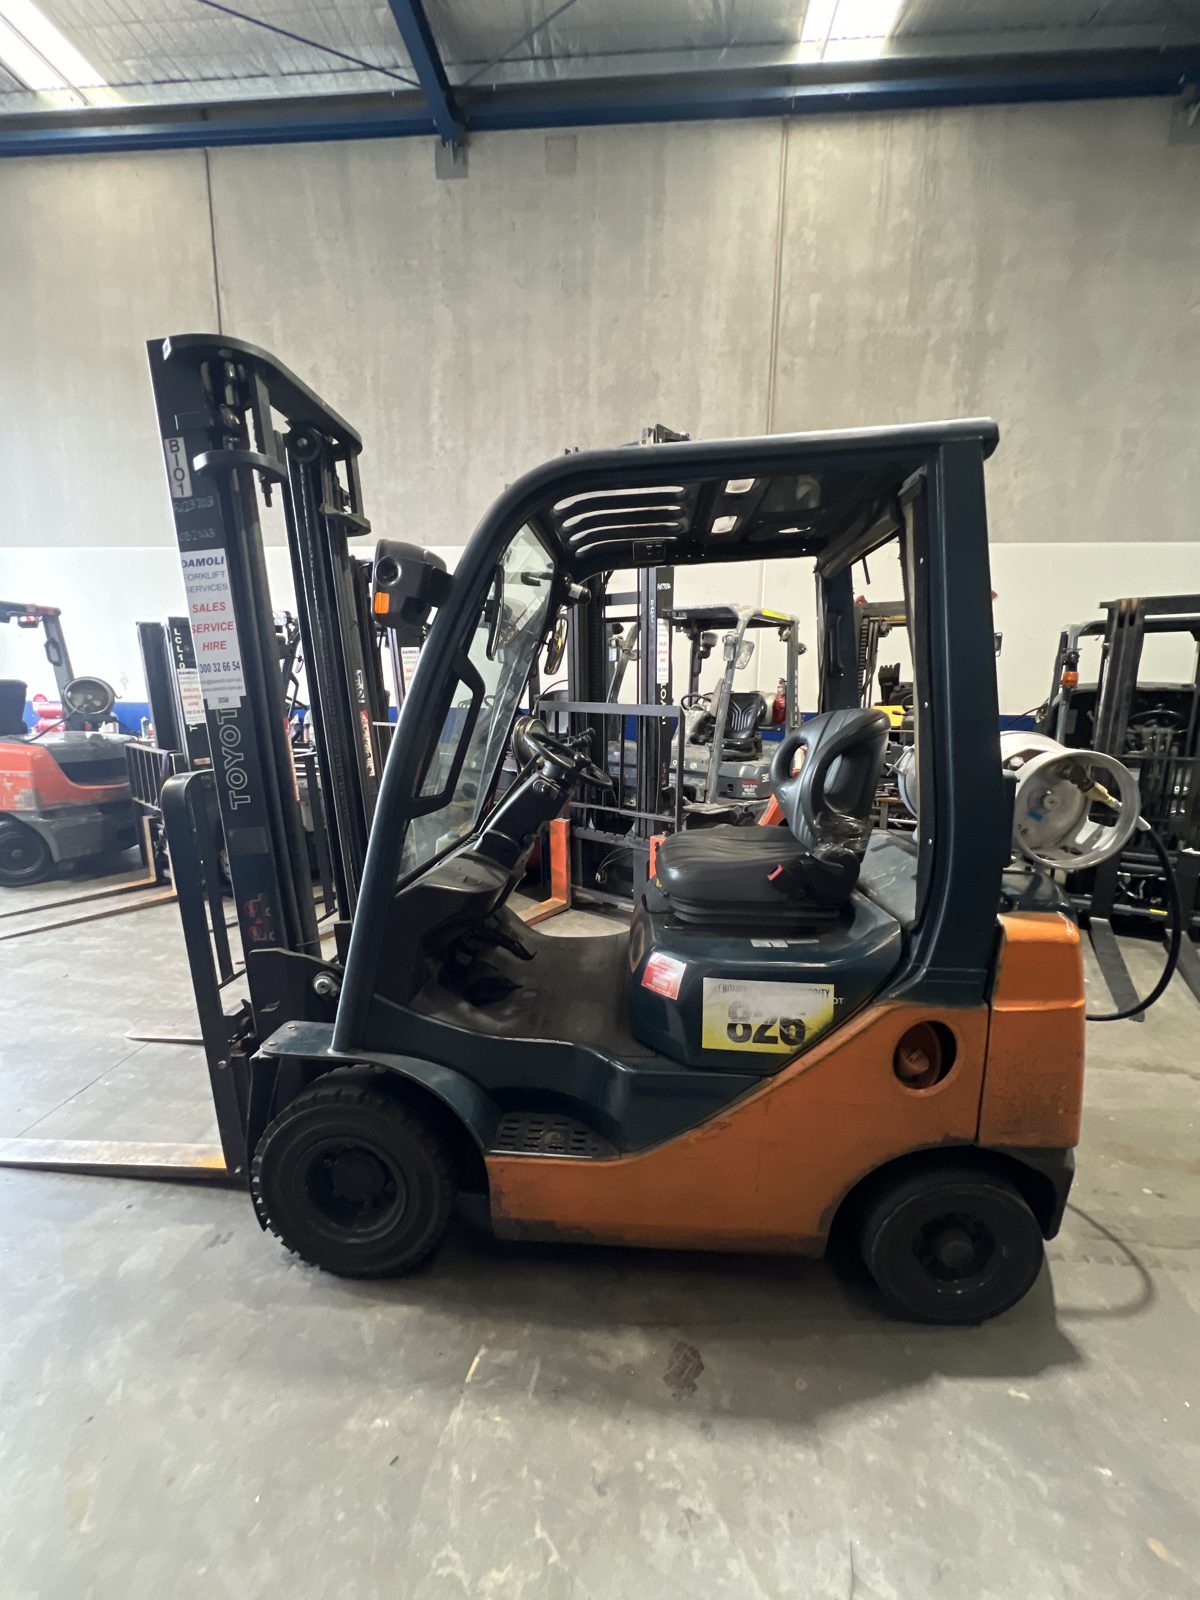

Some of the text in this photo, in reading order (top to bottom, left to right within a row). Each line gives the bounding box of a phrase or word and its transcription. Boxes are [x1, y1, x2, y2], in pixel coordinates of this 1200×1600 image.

[181, 556, 224, 568] DAMOLI
[186, 583, 229, 593] SERVICES
[192, 602, 226, 614] SALES
[192, 621, 234, 634] SERVICE
[202, 641, 227, 651] HIRE
[213, 662, 221, 673] 32
[223, 661, 231, 672] 66
[232, 660, 241, 671] 54
[216, 708, 250, 811] TOYOT
